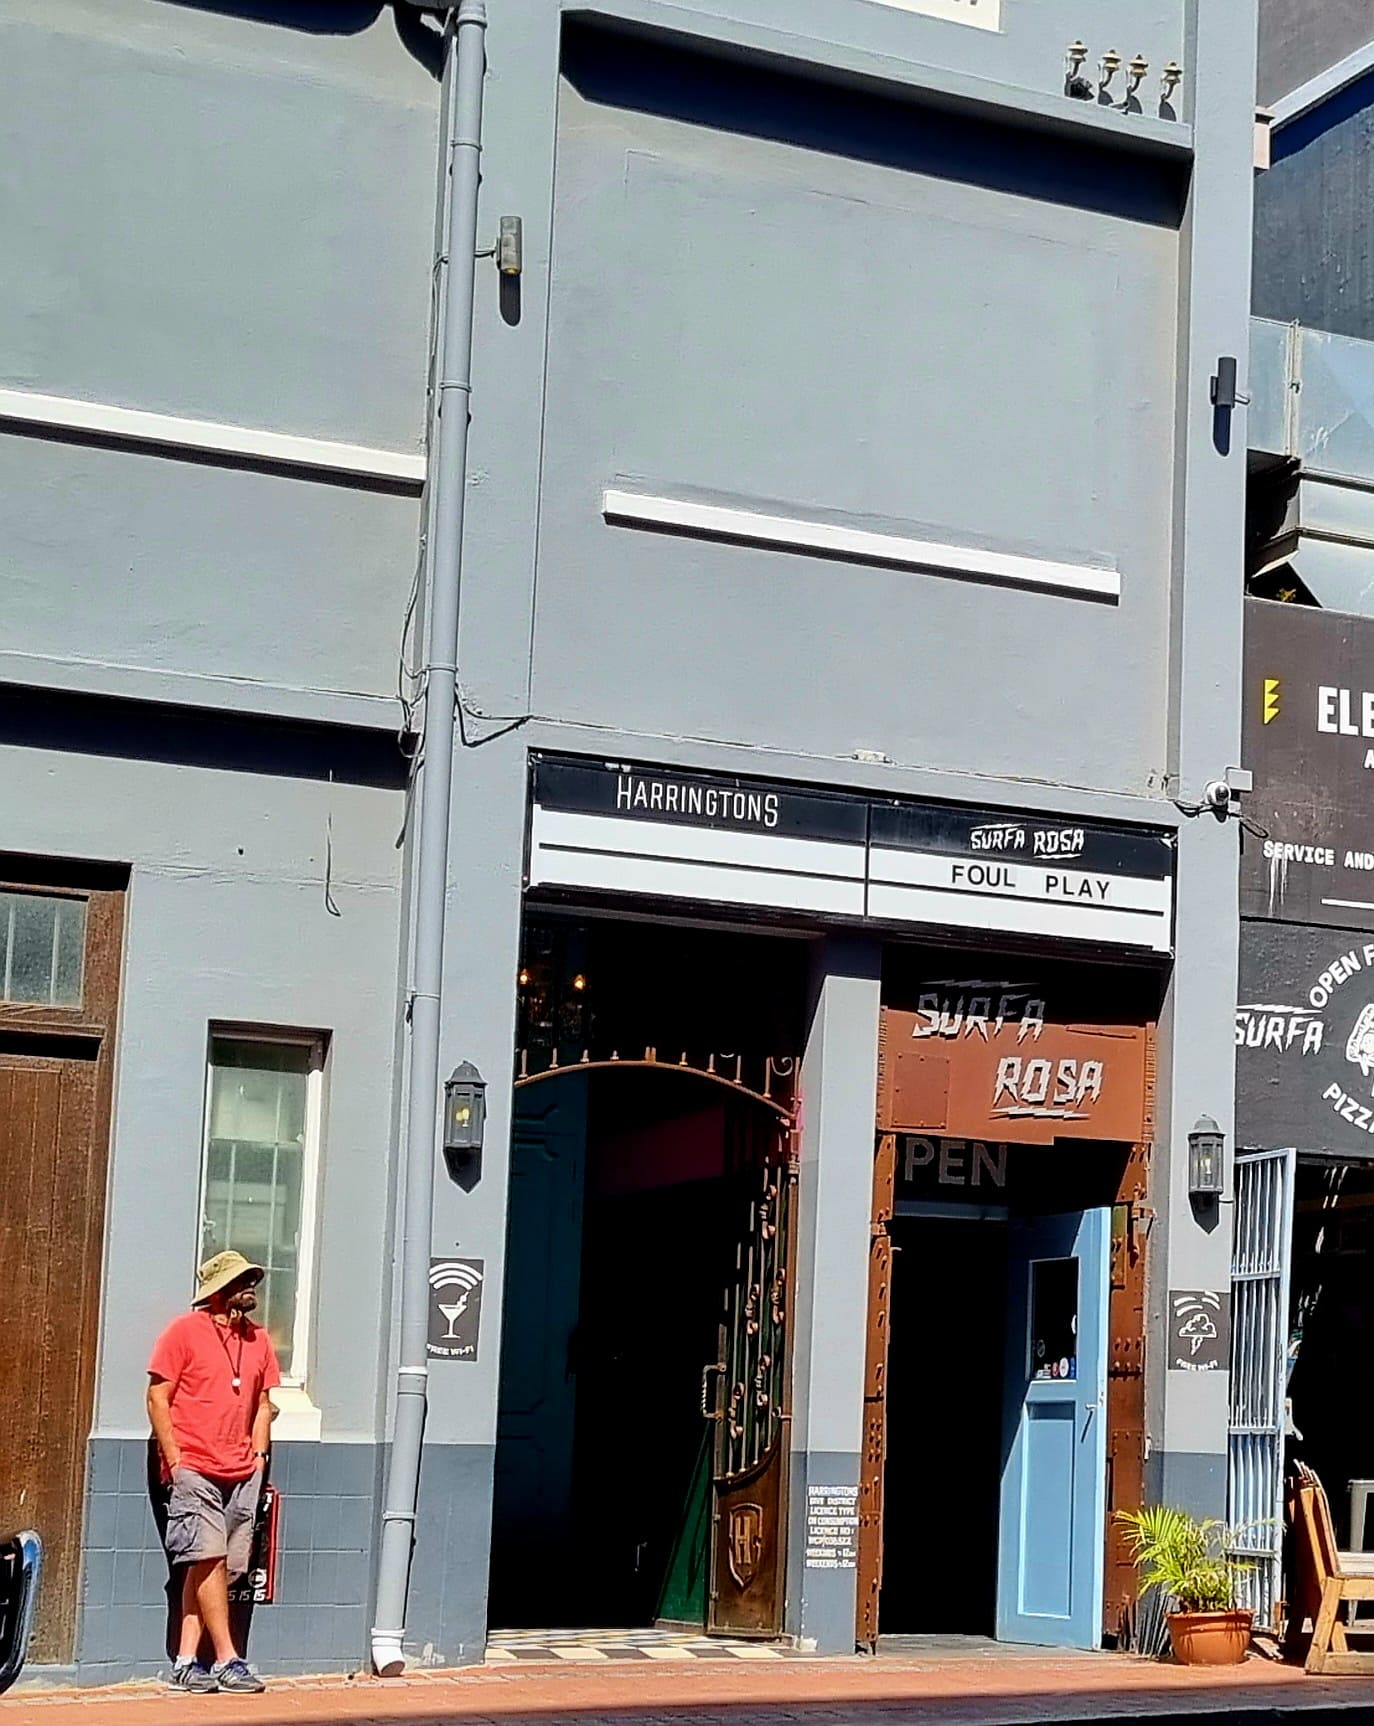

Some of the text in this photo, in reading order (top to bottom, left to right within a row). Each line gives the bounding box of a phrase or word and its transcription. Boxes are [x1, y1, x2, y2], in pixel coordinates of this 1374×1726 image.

[616, 775, 779, 828] HARRINGTONS
[970, 827, 1085, 855] SURFA ROSA
[1263, 840, 1335, 866] SERVICE
[1344, 851, 1374, 871] AND
[951, 864, 1111, 900] FOUL PLAY
[1309, 951, 1362, 1009] OPEN
[911, 992, 1046, 1045] SURFA
[1234, 1012, 1325, 1056] SURFA
[992, 1056, 1104, 1108] ROSA
[896, 1136, 1008, 1187] PEN
